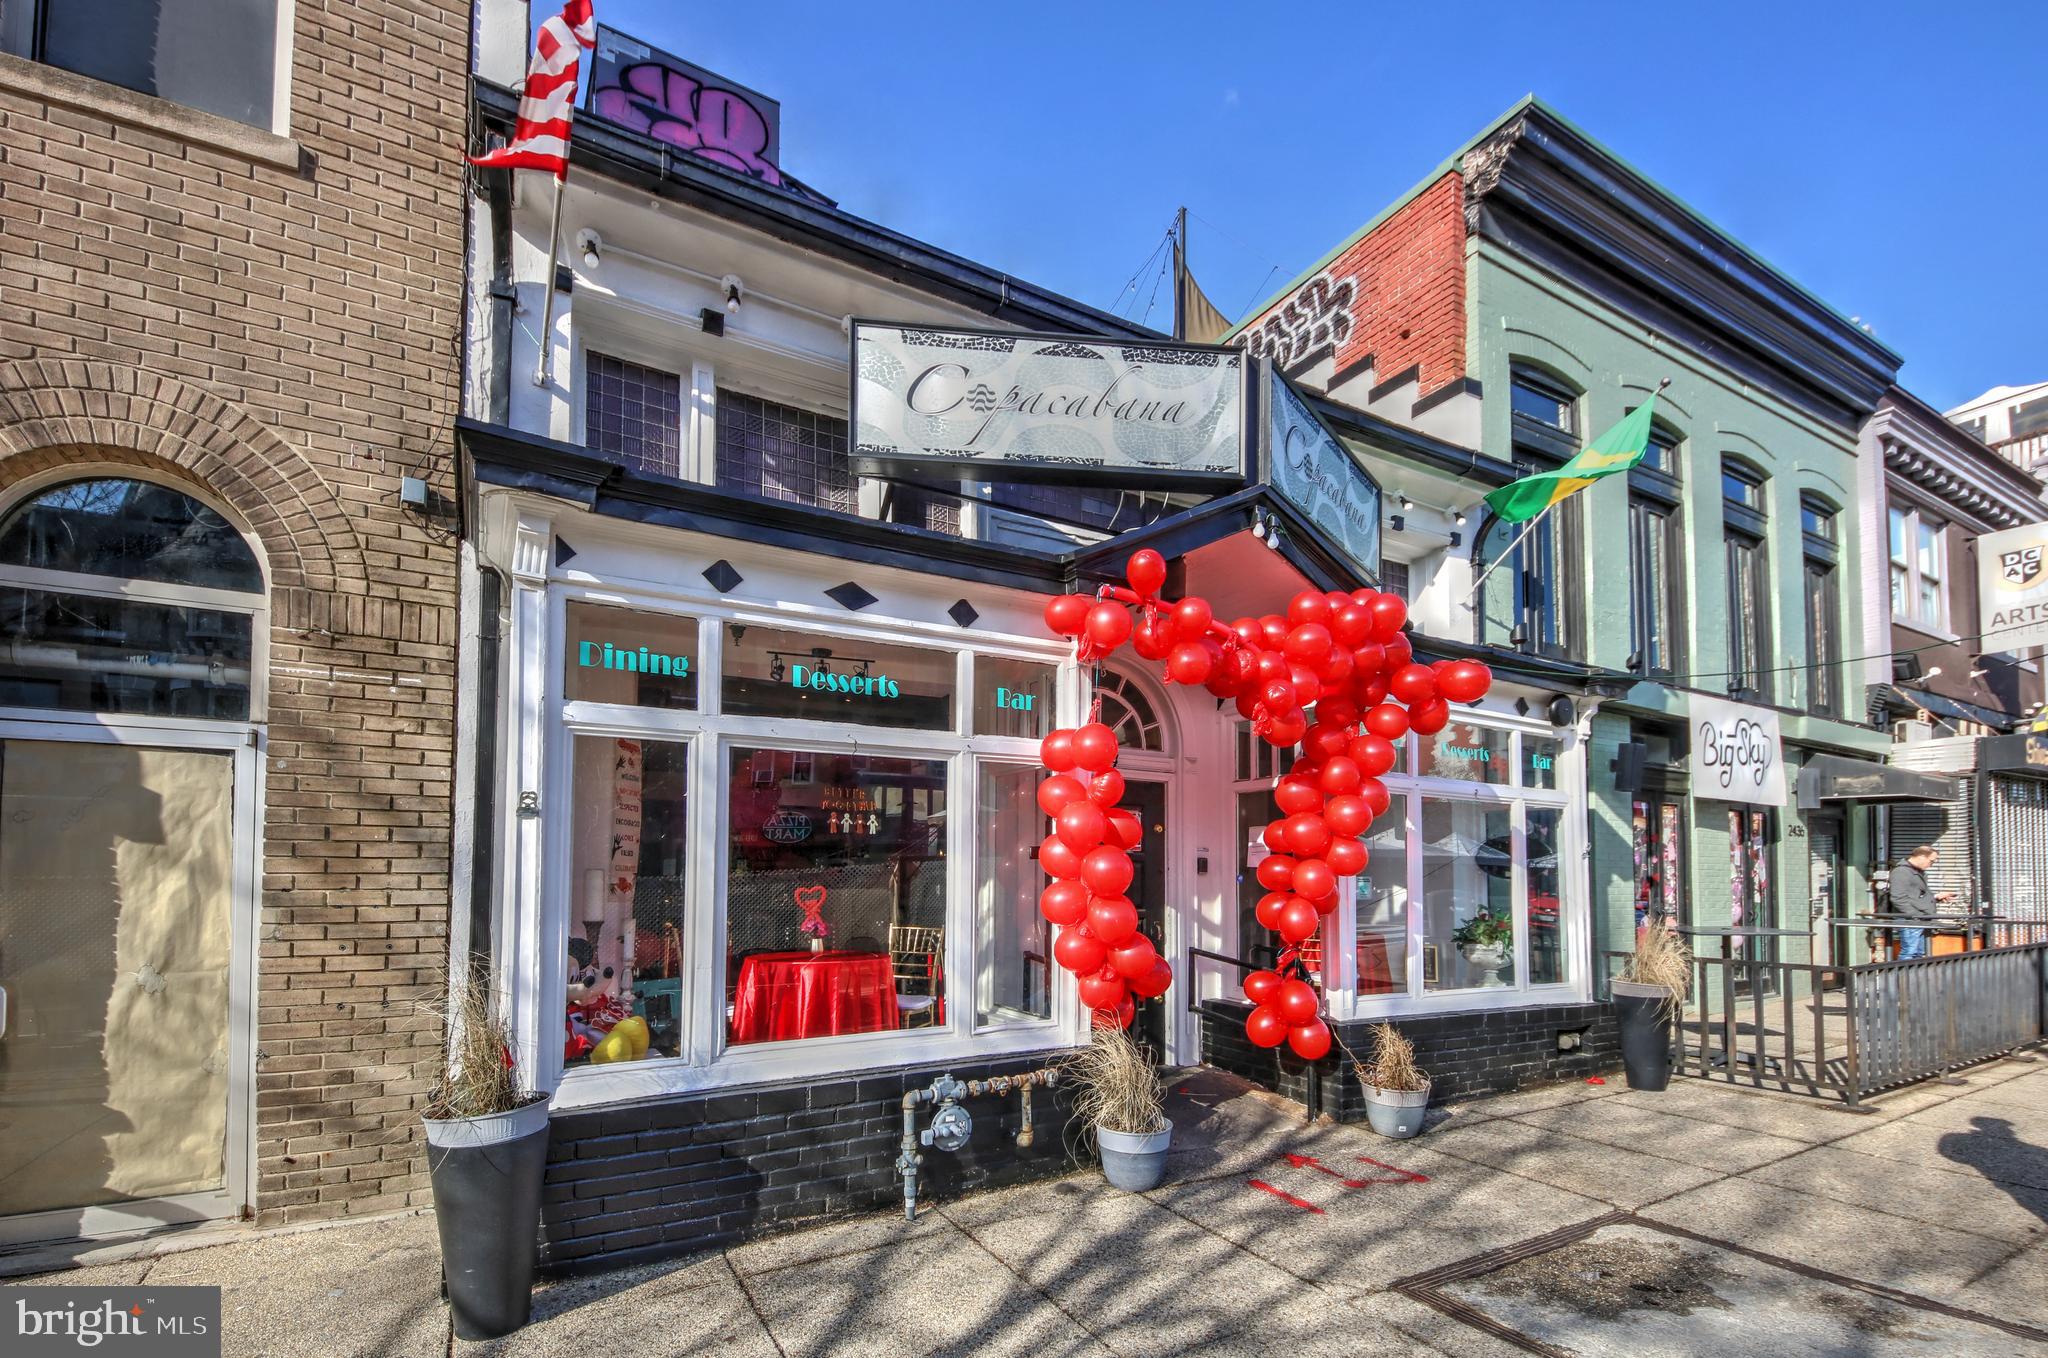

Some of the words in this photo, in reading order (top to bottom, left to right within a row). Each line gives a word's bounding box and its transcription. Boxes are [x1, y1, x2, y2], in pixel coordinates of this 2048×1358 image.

[579, 640, 689, 678] Dining
[792, 664, 900, 699] Desserts
[997, 687, 1037, 711] Bar
[1440, 741, 1490, 762] Desserts
[1532, 753, 1553, 770] Bar
[1699, 721, 1734, 788] Big
[1737, 722, 1767, 787] Sky
